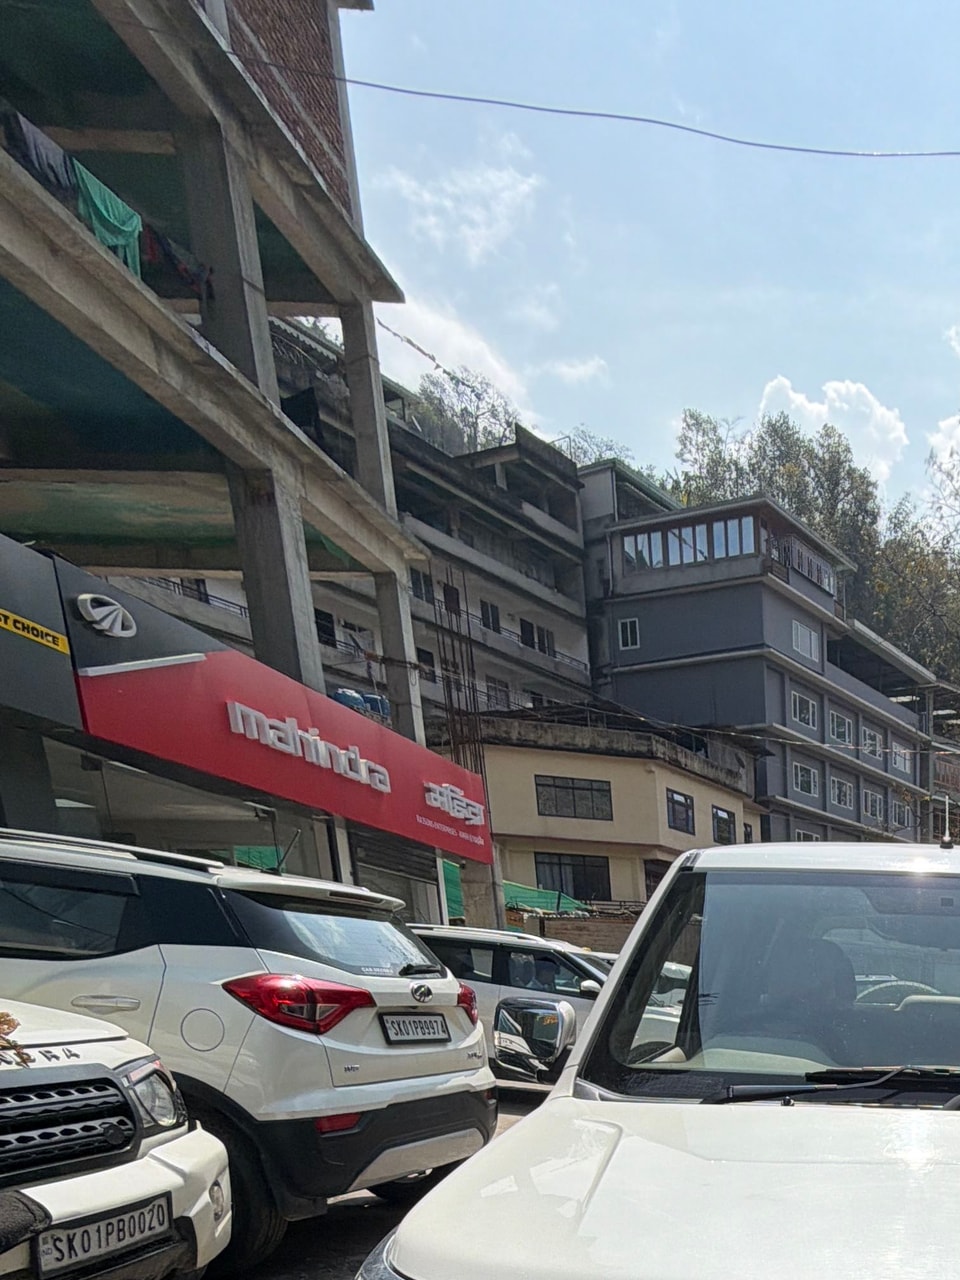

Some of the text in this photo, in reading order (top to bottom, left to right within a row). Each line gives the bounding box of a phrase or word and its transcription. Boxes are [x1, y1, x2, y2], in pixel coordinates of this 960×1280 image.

[13, 618, 60, 648] CHOICE
[226, 701, 392, 793] mahindra
[391, 1020, 447, 1037] SK01PB9974
[52, 1203, 165, 1262] SK01PB0020
